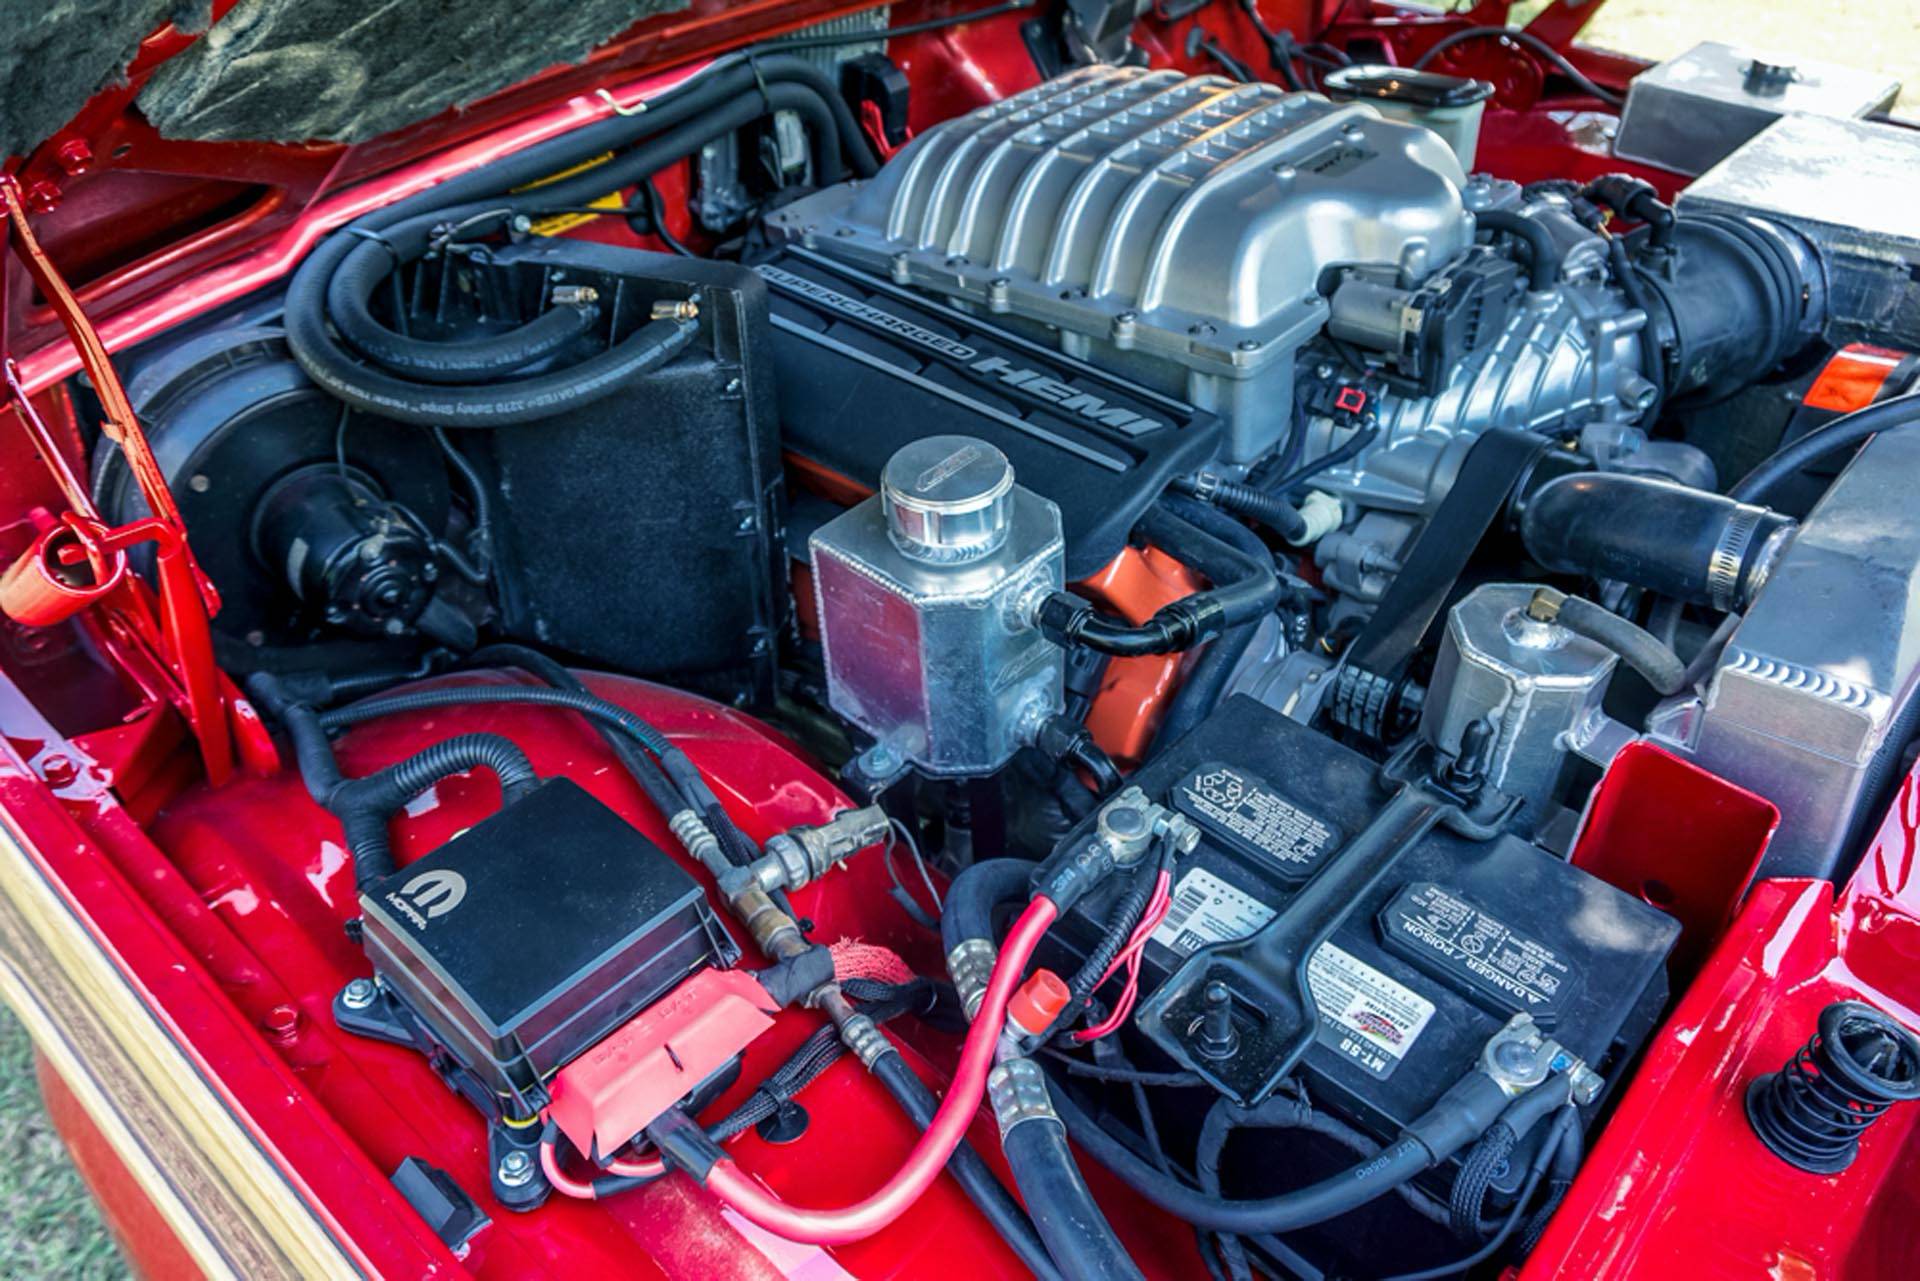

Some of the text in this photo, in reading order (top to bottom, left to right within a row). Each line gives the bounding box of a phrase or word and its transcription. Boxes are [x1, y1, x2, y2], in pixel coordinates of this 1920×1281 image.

[759, 266, 1163, 436] SUPERCHARGED HEMI
[494, 396, 524, 416] 3270
[1402, 921, 1454, 956] POISON
[1466, 957, 1527, 998] DANGER
[1339, 1038, 1386, 1072] MT-58
